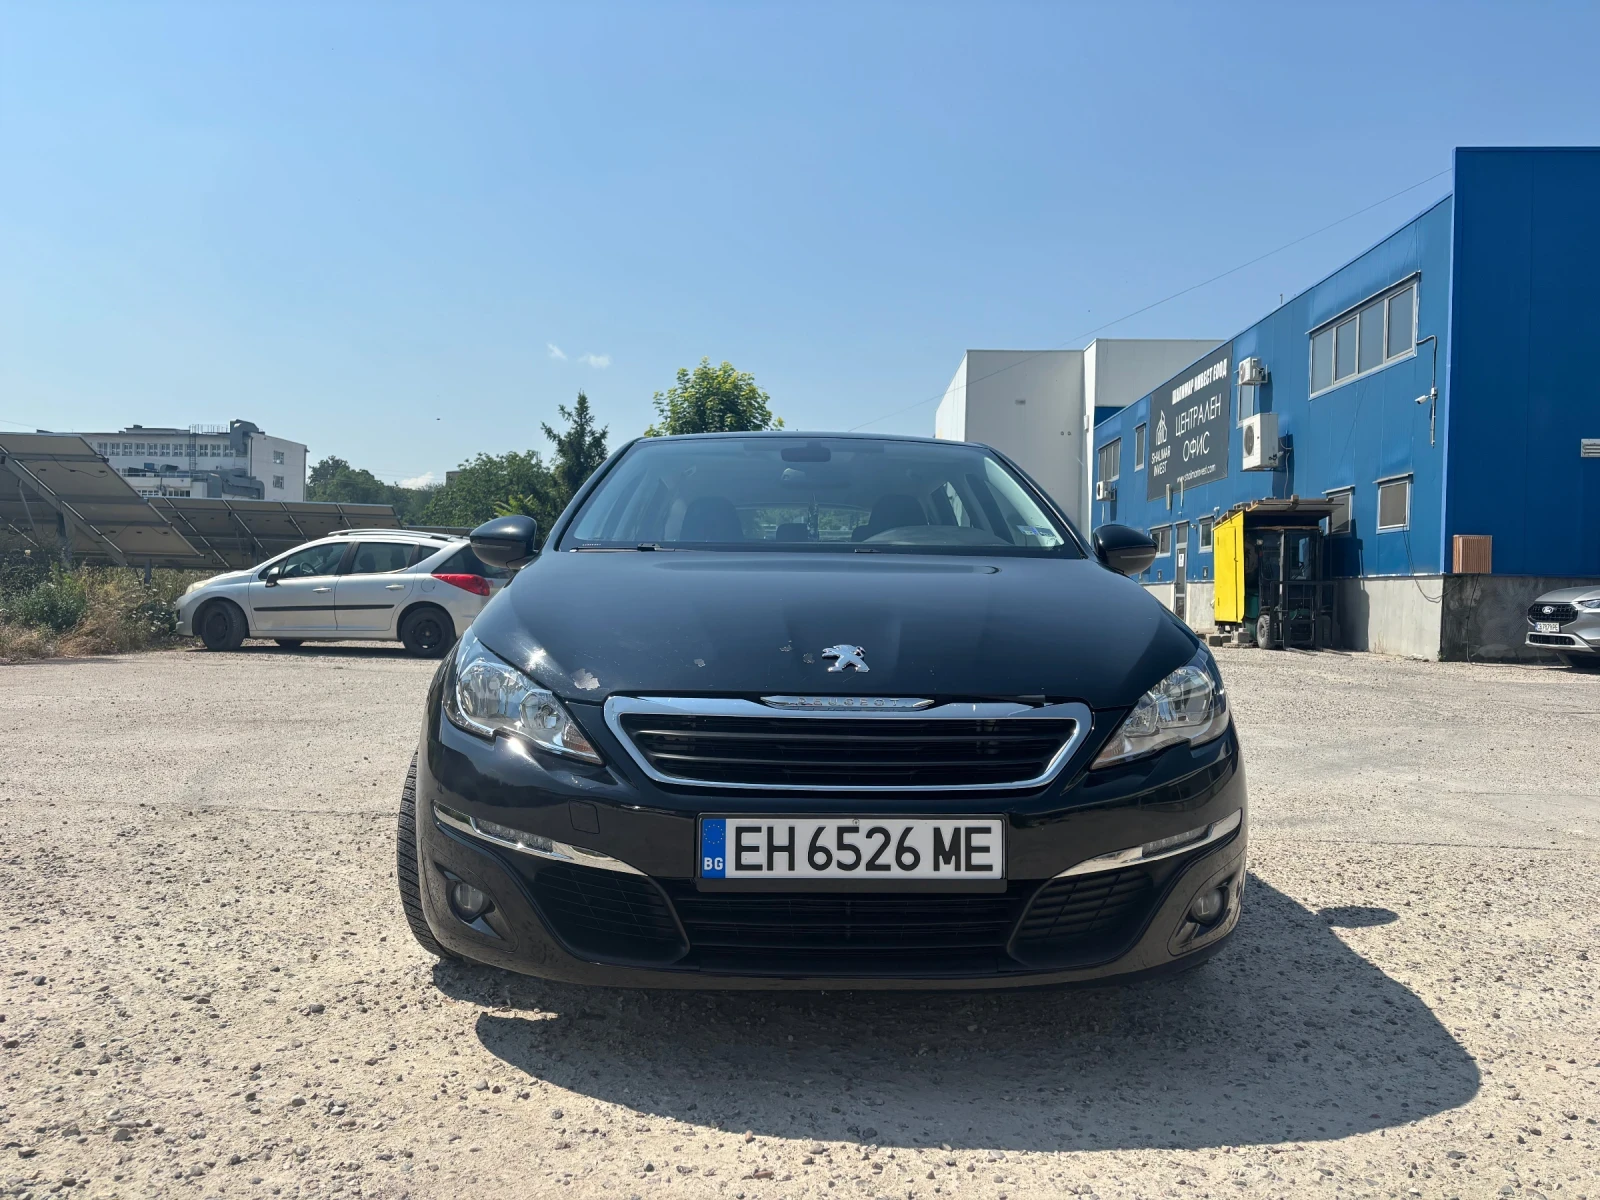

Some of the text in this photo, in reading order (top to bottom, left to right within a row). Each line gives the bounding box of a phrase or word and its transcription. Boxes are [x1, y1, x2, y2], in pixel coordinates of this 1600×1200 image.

[1175, 393, 1222, 438] ЦЕНТРАЛЕН
[1152, 446, 1170, 464] SHALIMAR
[1182, 431, 1210, 462] ОФИС
[1154, 461, 1168, 476] INVEST
[798, 698, 900, 707] PEUGEOT
[734, 826, 994, 872] EH 6526 ME
[703, 858, 724, 871] BG
